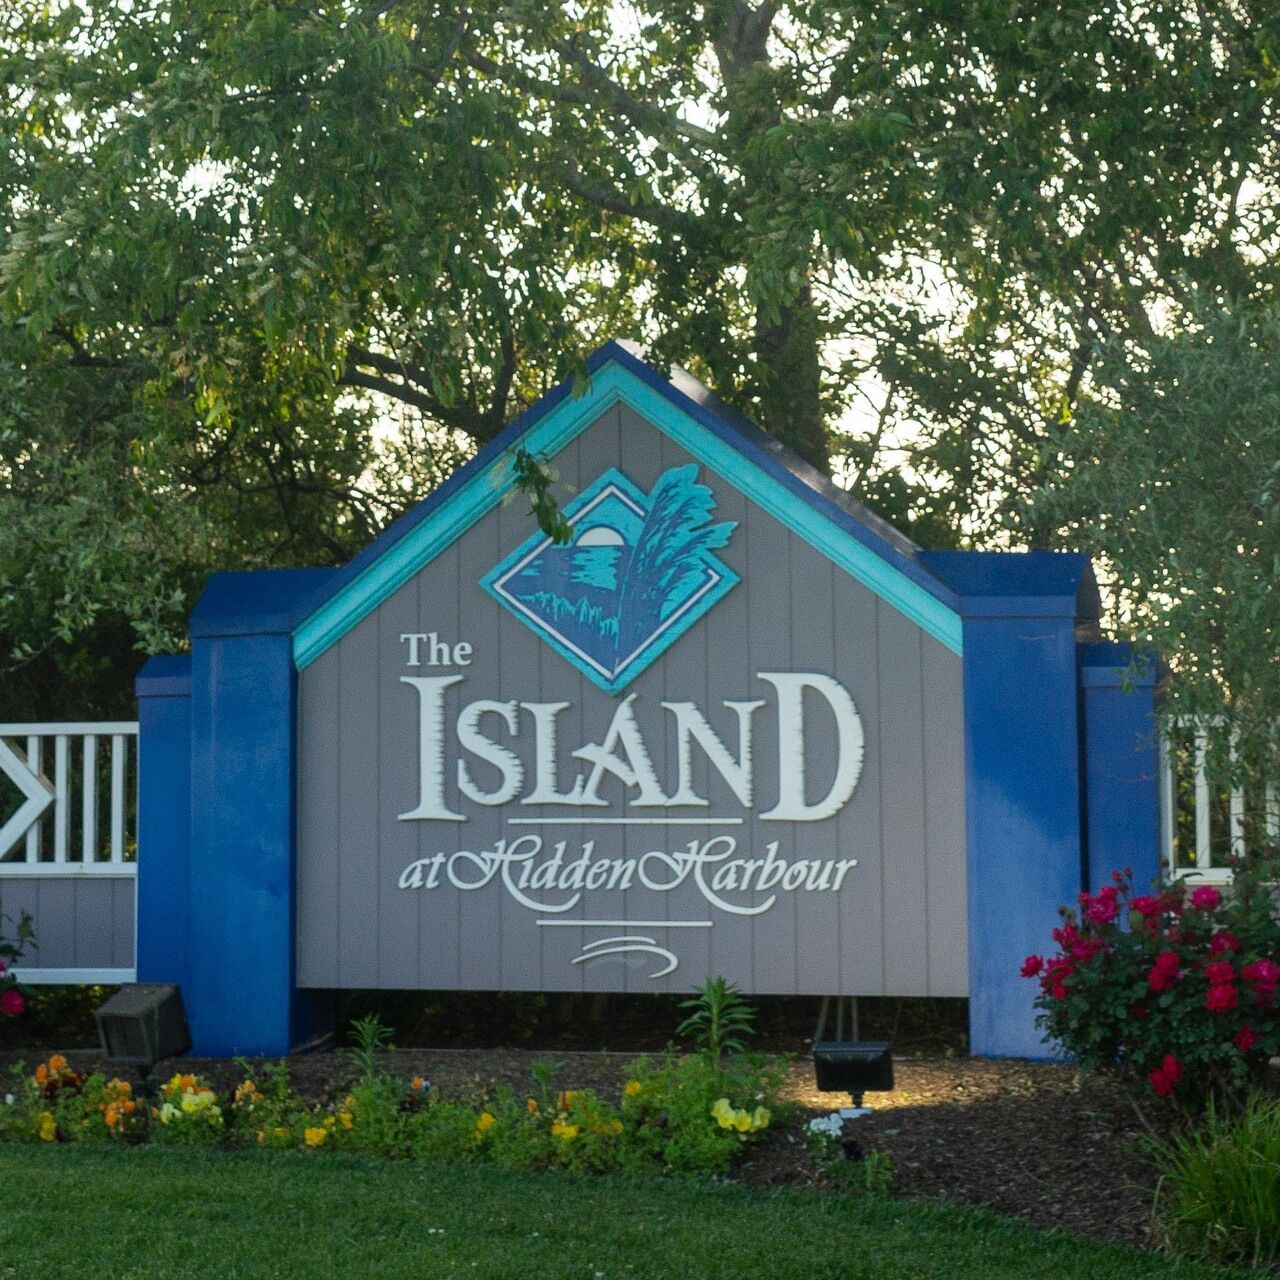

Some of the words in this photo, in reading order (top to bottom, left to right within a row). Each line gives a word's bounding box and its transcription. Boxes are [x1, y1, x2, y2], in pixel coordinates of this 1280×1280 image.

[400, 632, 472, 666] The
[397, 671, 865, 822] ISLAND
[398, 849, 444, 890] at
[447, 834, 635, 913] Hidden
[638, 835, 858, 915] Harbour
